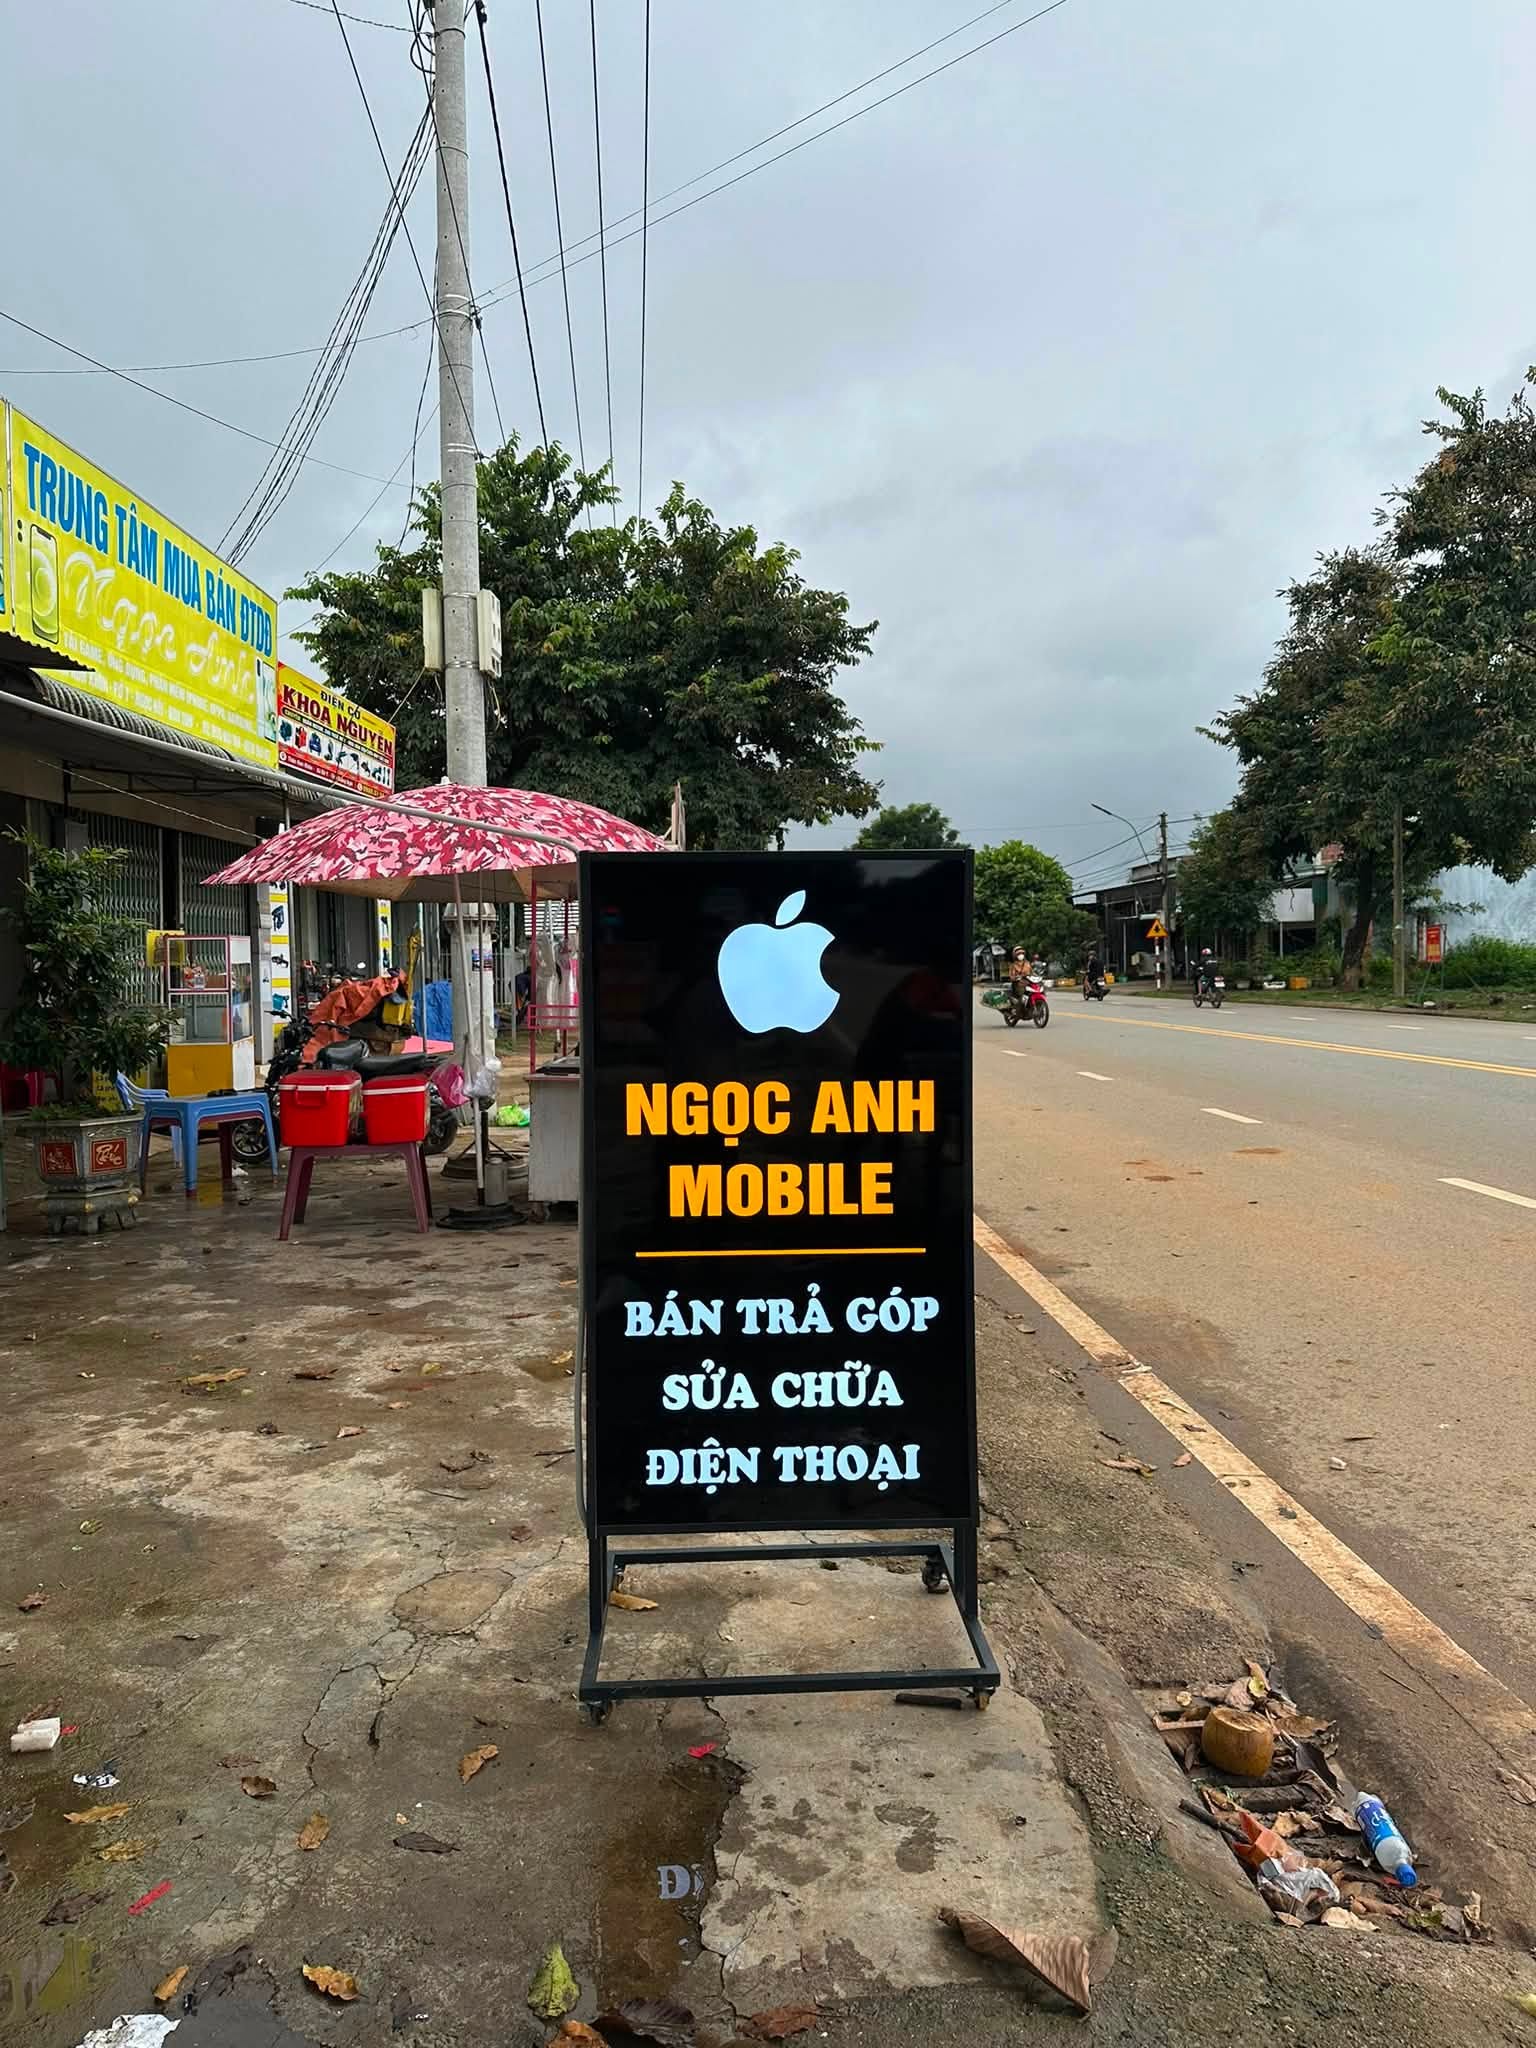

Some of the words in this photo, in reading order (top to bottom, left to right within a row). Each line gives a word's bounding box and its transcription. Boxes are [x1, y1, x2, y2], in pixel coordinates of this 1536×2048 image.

[24, 443, 108, 554] TRUNG
[115, 504, 158, 584] TÂM
[163, 540, 201, 611] MUA
[206, 566, 236, 634] BÁN
[283, 684, 332, 725] KHOA
[625, 1080, 791, 1147] NGỌC
[811, 1080, 935, 1134] ANH
[669, 1162, 894, 1218] MOBILE
[624, 1290, 724, 1337] BÁN
[736, 1283, 833, 1334] TRẢ
[846, 1287, 939, 1333] GÓP
[663, 1359, 760, 1411] SỬA
[772, 1360, 904, 1409] CHỮA
[646, 1437, 761, 1495] ĐIỆN
[773, 1444, 920, 1491] THOẠI
